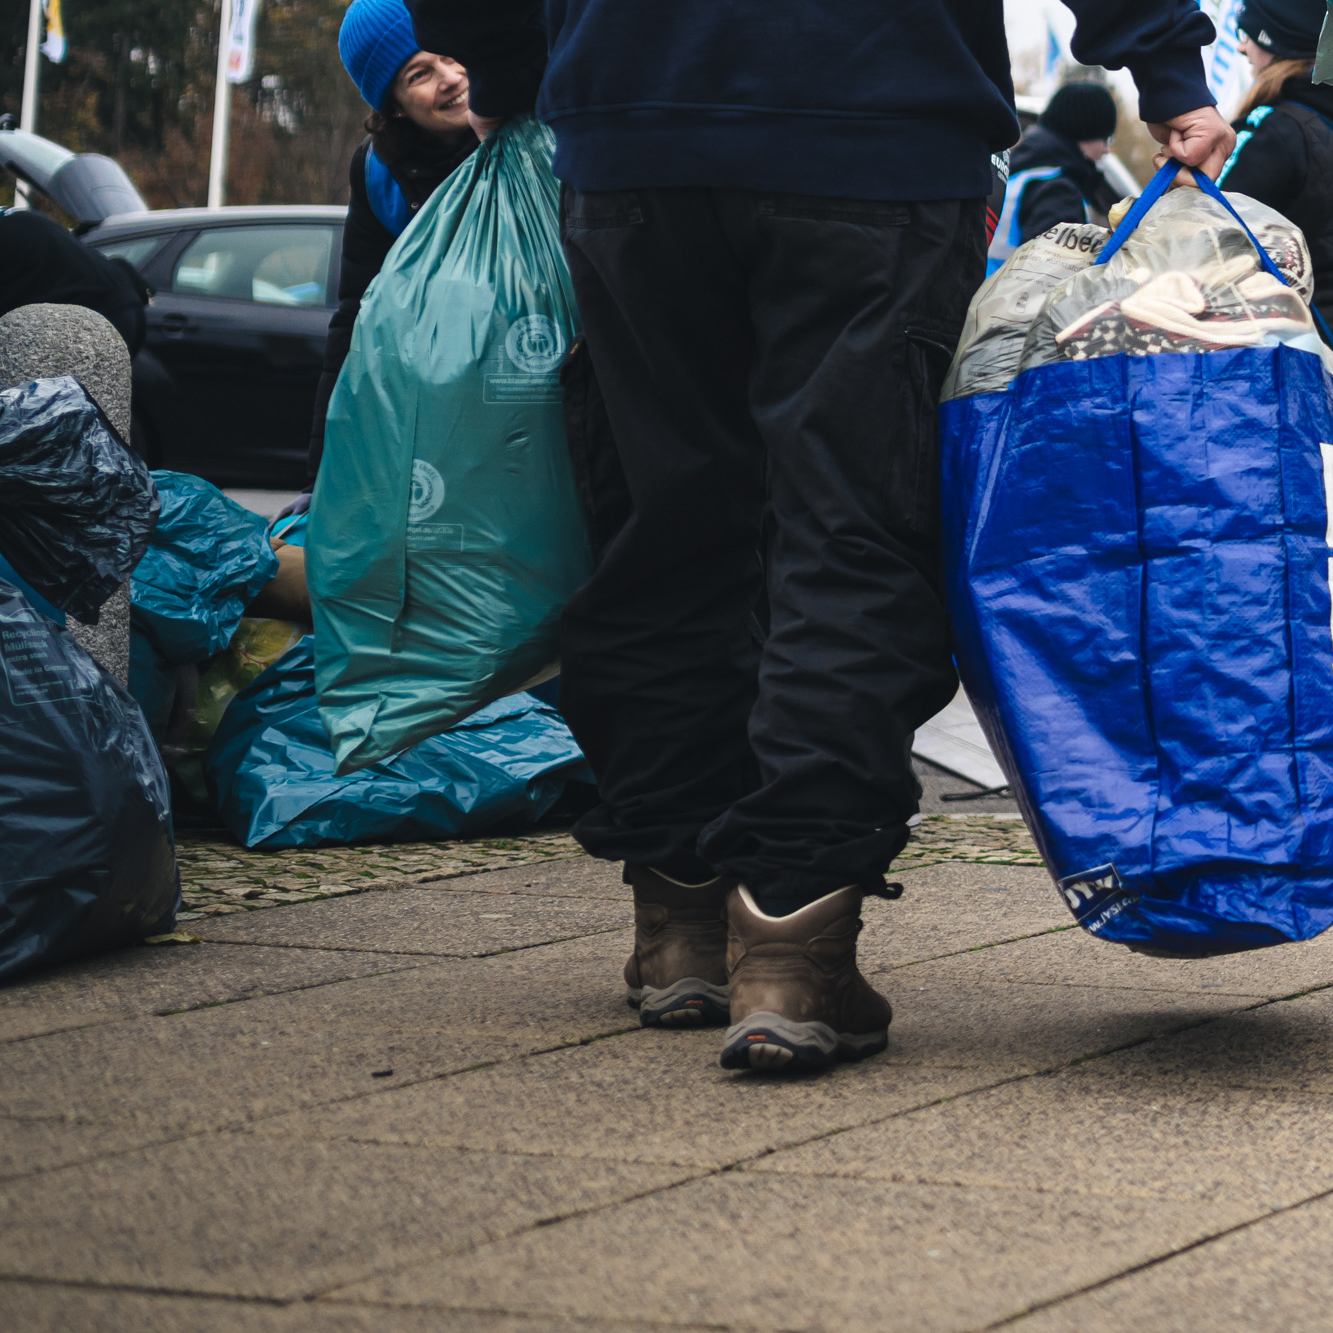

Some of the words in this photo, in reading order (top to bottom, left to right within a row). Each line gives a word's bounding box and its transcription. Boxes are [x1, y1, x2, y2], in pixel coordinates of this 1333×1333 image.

[1037, 226, 1105, 254] elber
[2, 629, 50, 640] Recycling-
[4, 640, 48, 652] Müllsack
